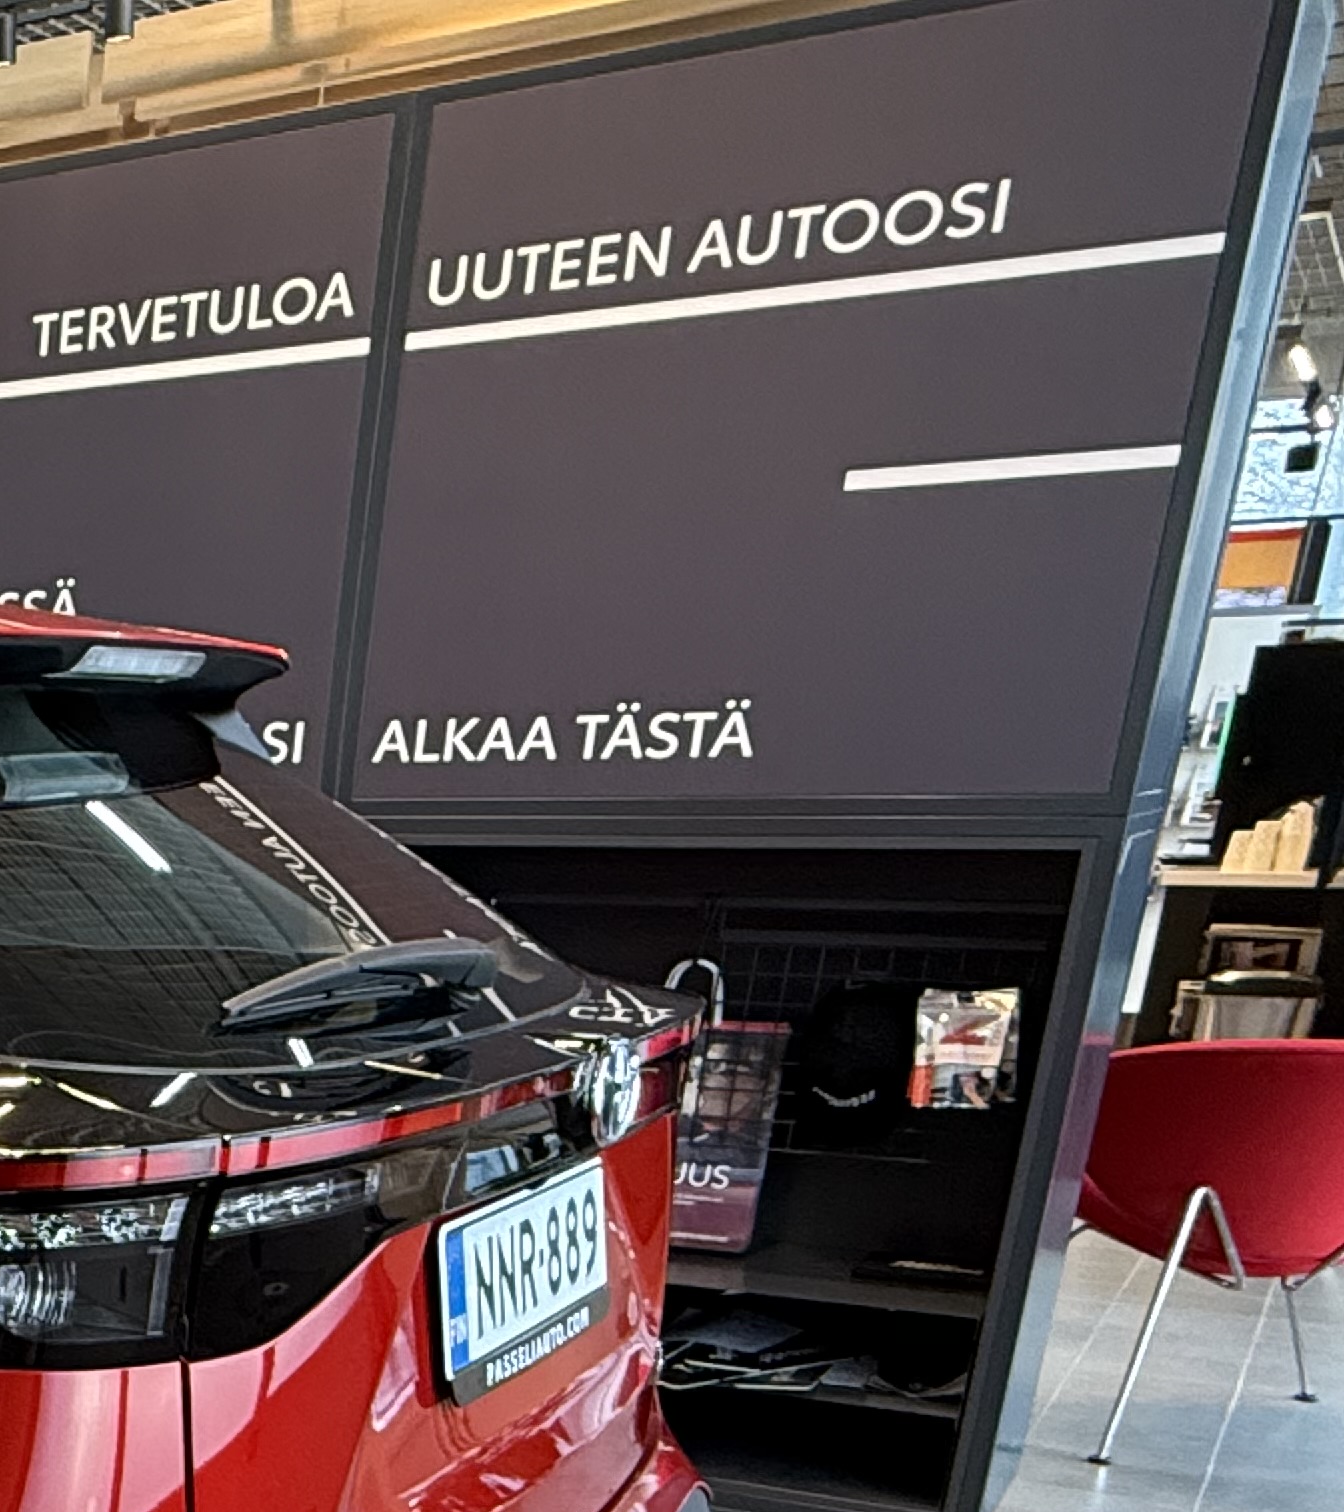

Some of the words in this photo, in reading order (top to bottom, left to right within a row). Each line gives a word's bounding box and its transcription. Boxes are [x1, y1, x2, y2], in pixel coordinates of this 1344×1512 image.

[32, 271, 354, 357] TERVETULOA
[428, 227, 672, 307] UUTEEN
[687, 178, 1012, 273] AUTOOSI
[371, 715, 558, 763] ALKAA
[575, 699, 754, 761] TÄSTÄ
[474, 1188, 598, 1340] NNR-889
